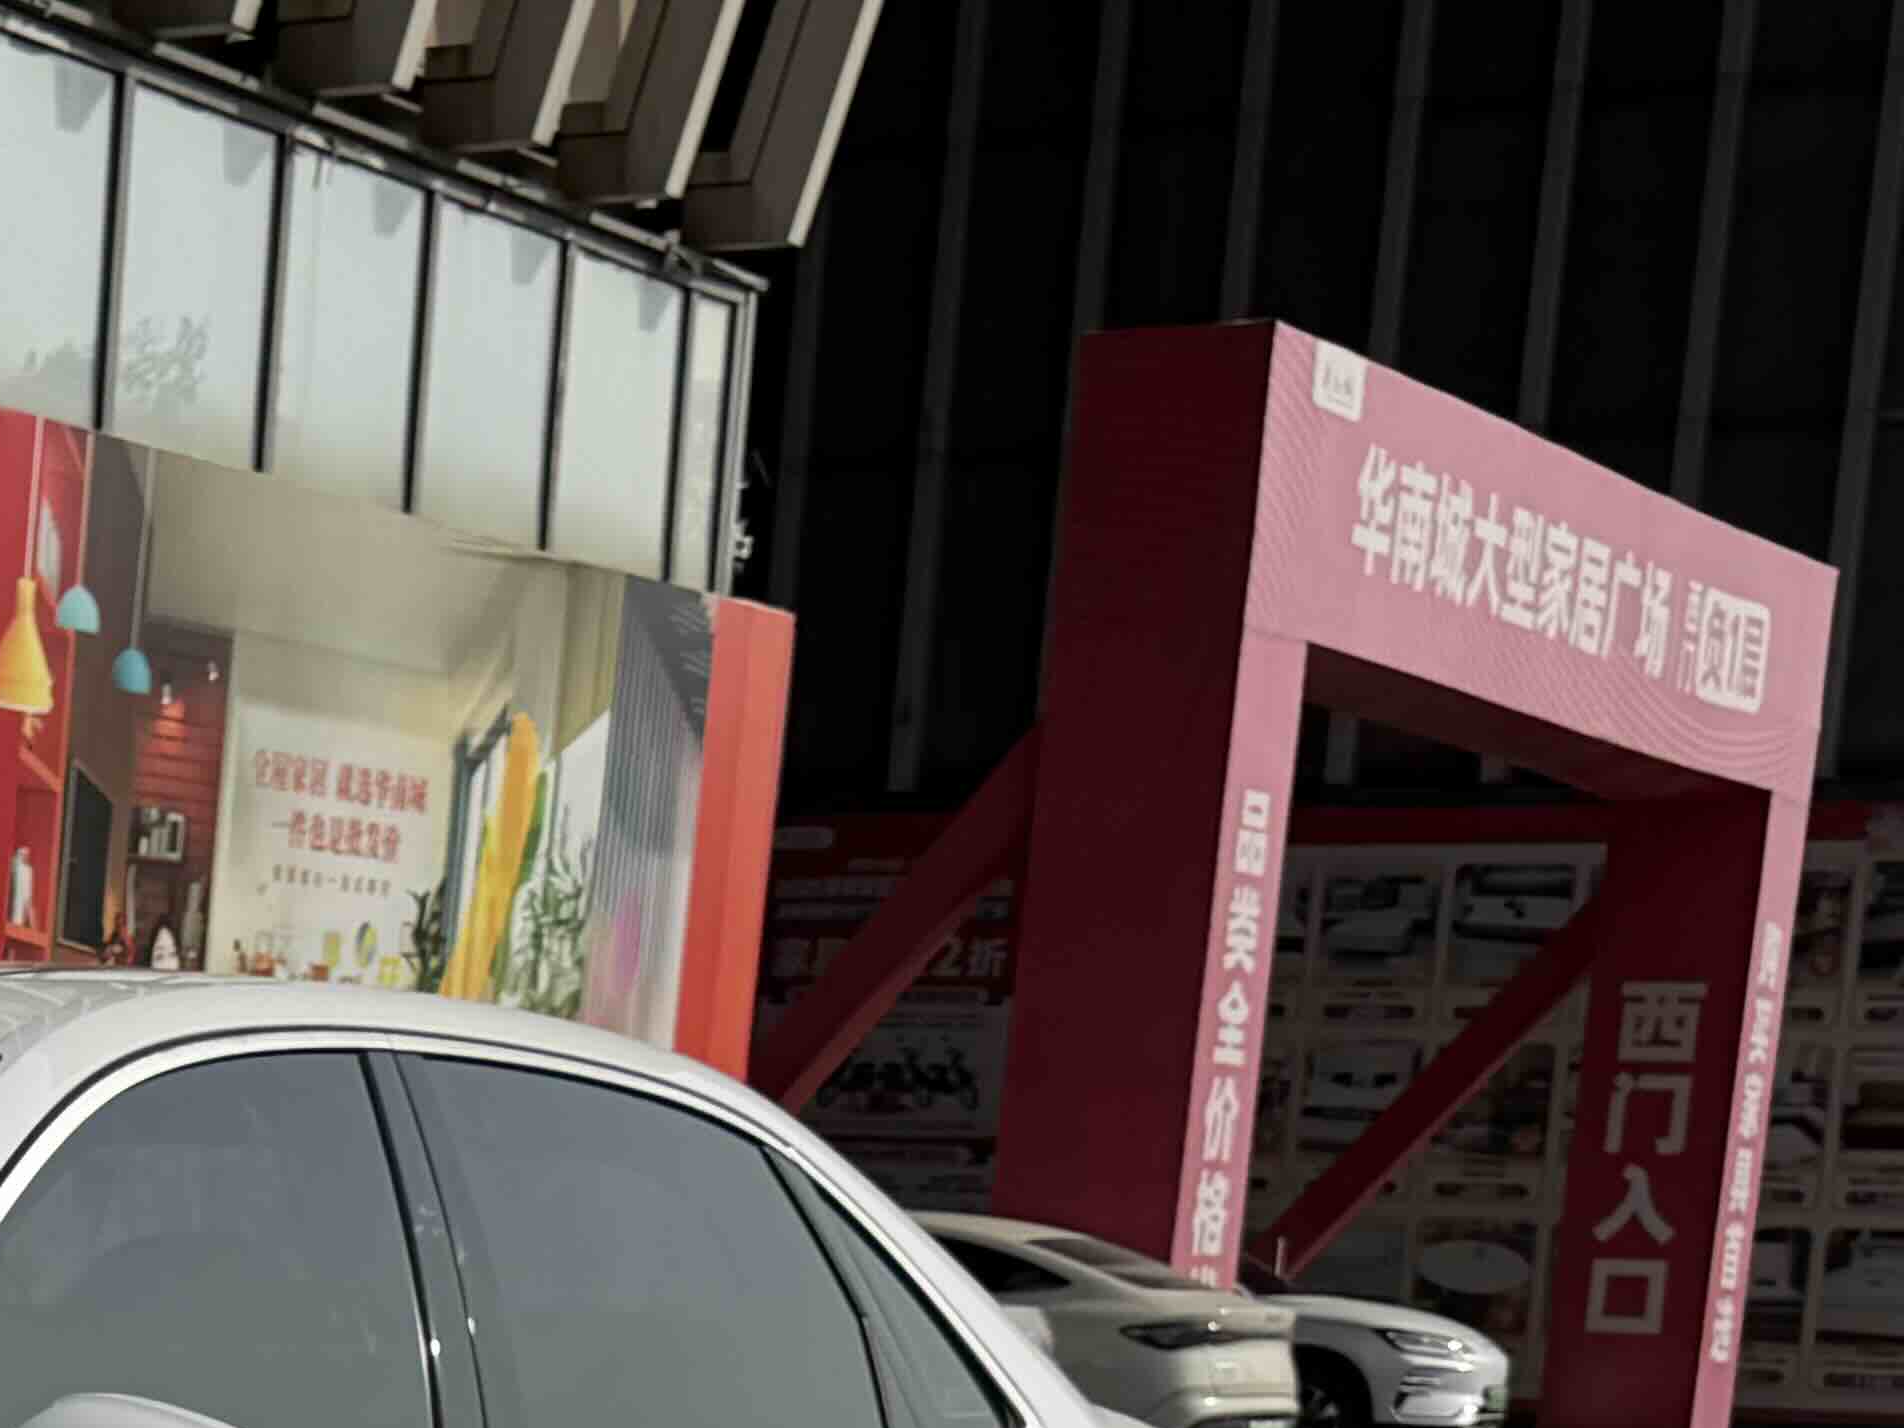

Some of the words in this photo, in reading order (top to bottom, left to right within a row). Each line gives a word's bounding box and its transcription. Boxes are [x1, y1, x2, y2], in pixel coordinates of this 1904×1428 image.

[1350, 443, 1673, 681] 华南城大型家居广场
[1584, 980, 1709, 1336] 西门入口
